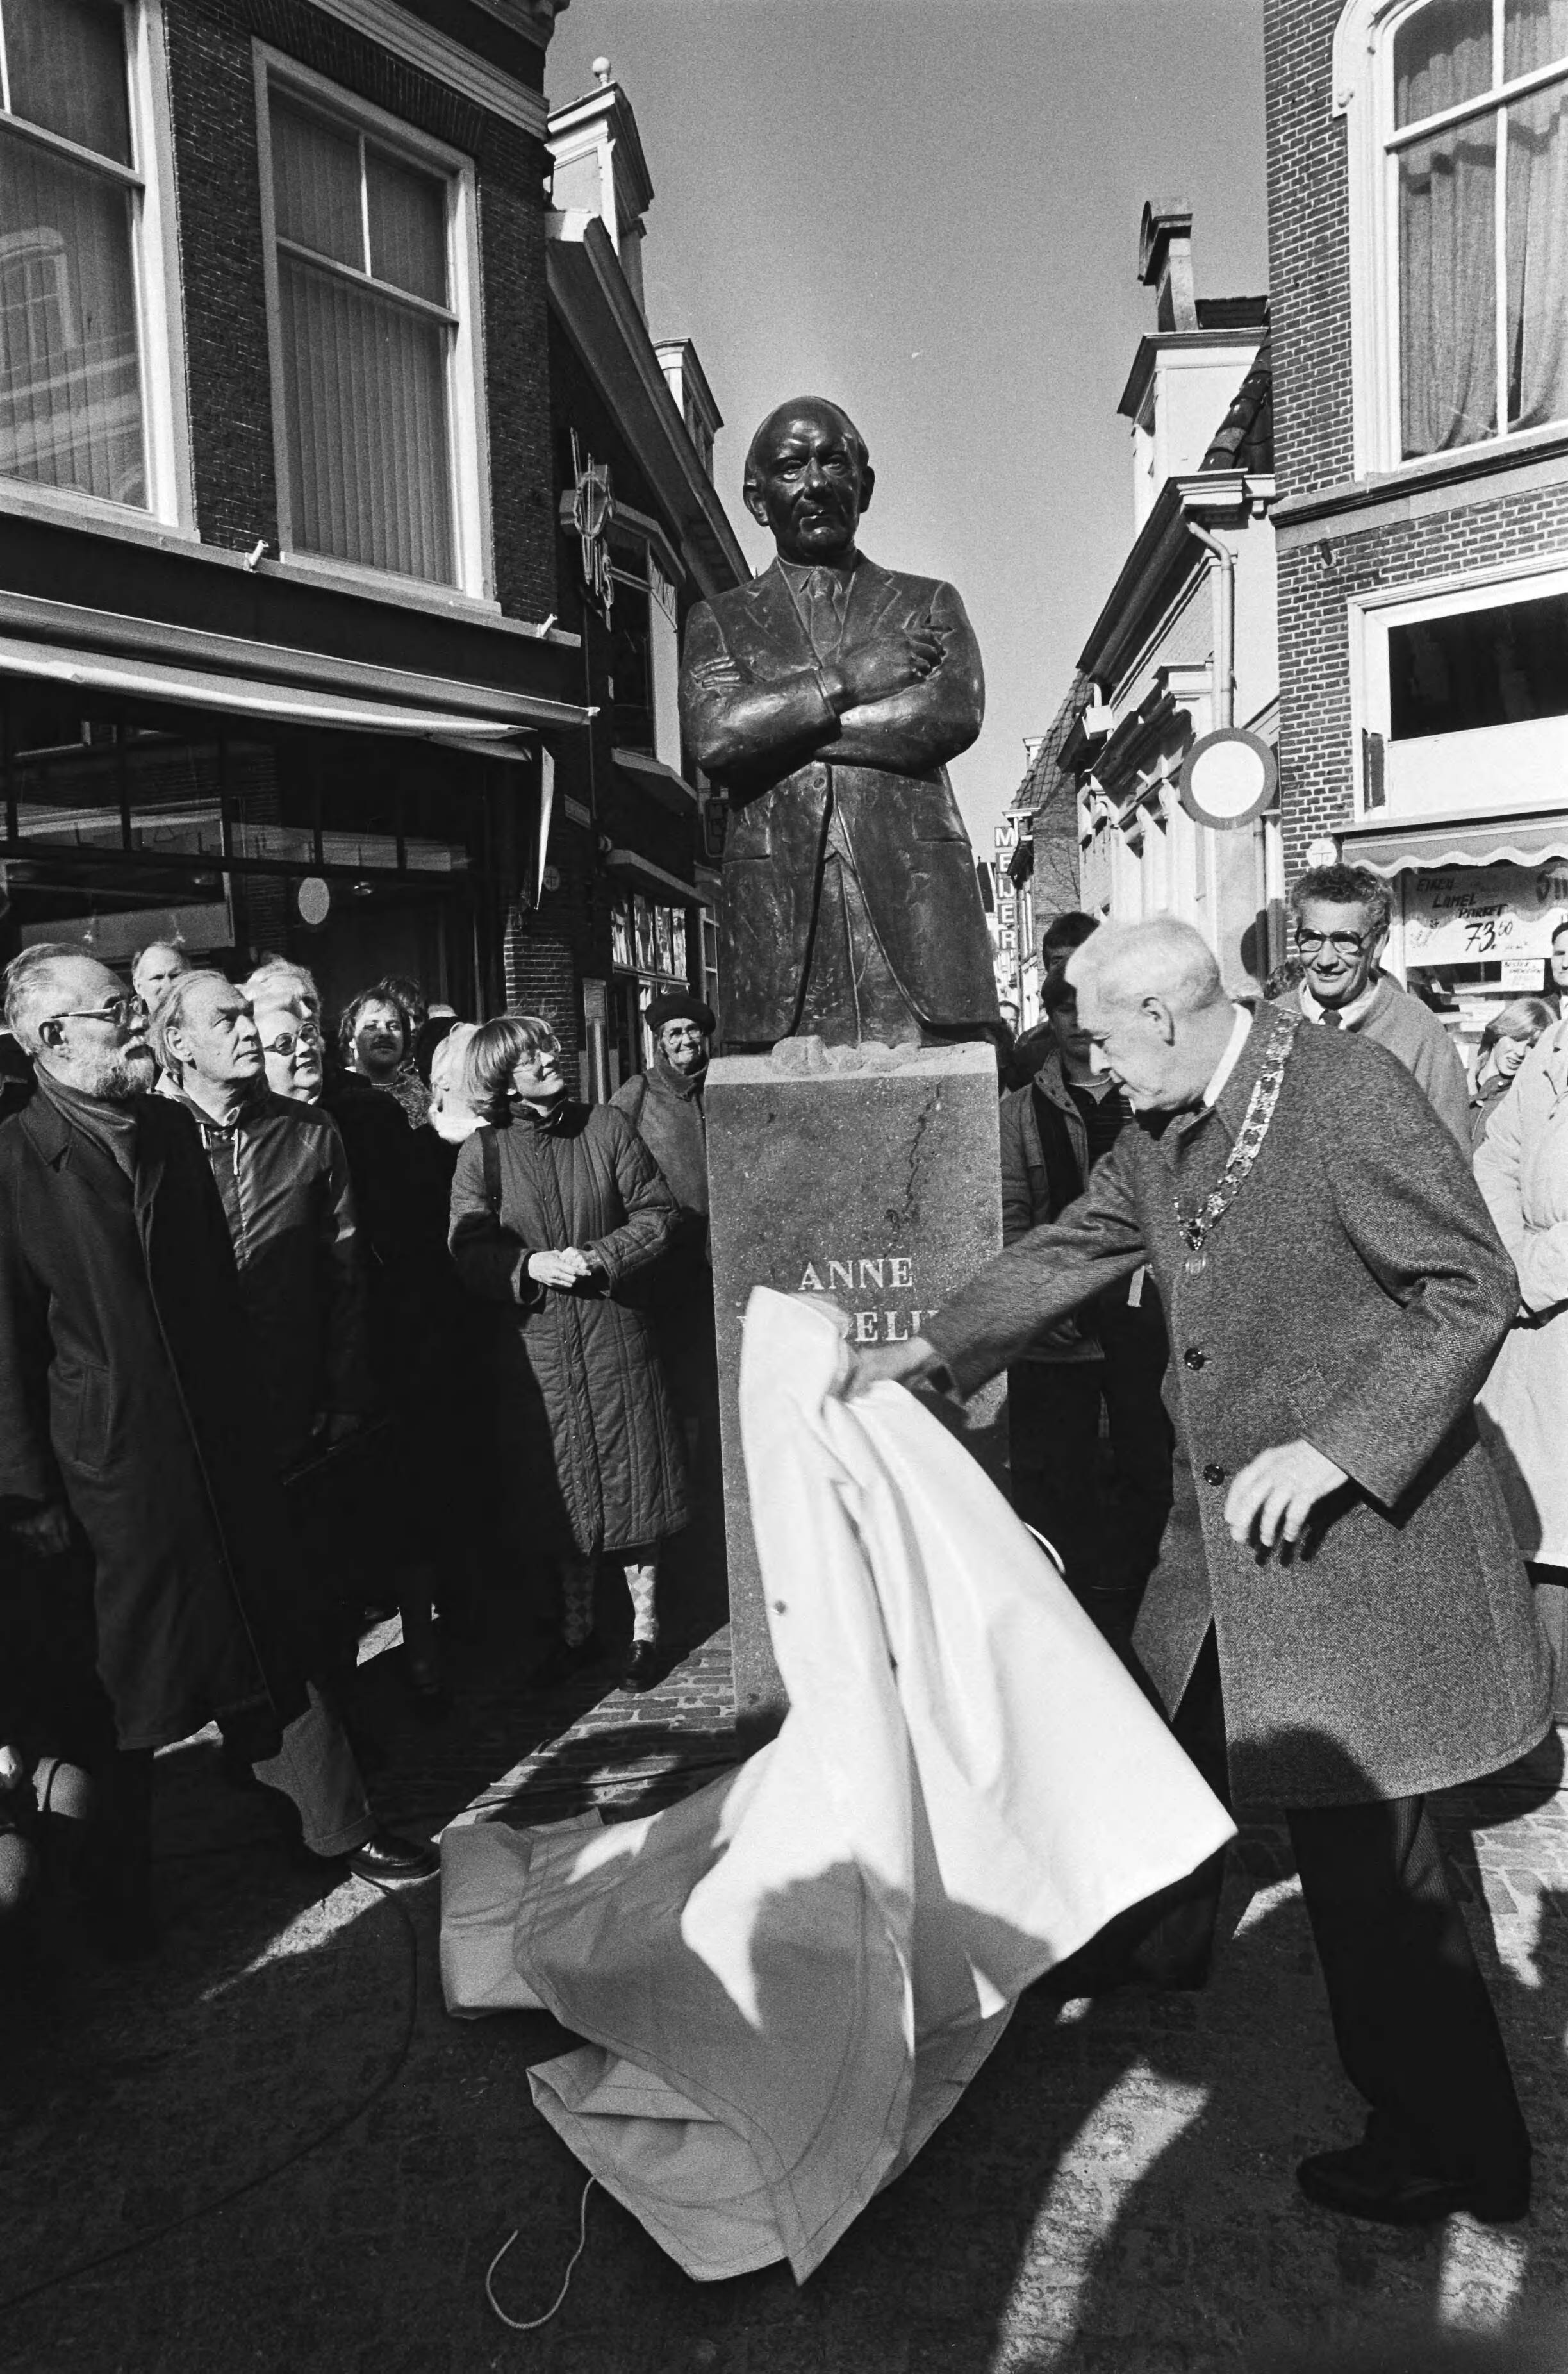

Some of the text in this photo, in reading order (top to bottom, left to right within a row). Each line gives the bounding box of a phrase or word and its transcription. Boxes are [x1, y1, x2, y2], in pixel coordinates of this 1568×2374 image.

[1432, 893, 1476, 909] LAMEL
[1458, 904, 1508, 918] PARKET
[798, 1258, 913, 1290] ANNE
